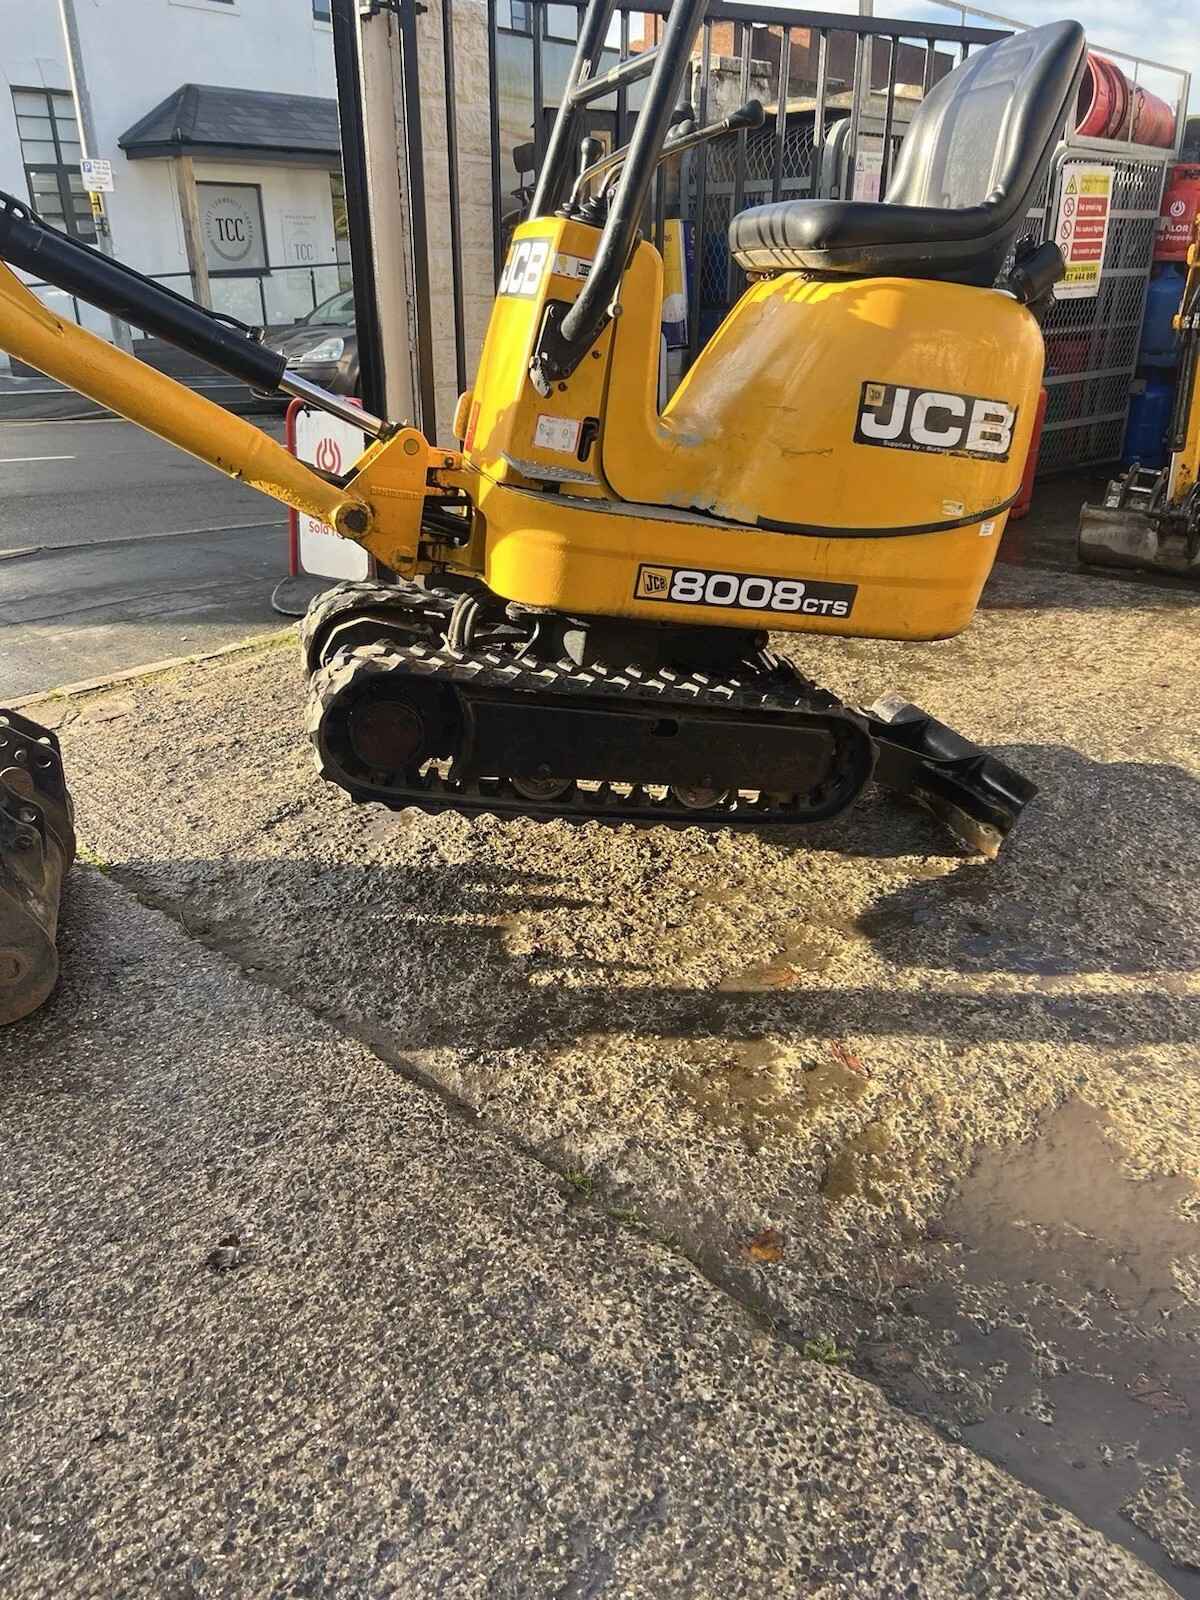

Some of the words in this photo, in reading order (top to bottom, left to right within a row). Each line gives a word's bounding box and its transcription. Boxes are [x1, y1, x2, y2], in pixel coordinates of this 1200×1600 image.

[215, 217, 245, 242] TCC
[293, 243, 314, 261] TCC
[500, 241, 549, 295] JCB
[860, 388, 1015, 454] JCB
[645, 574, 667, 592] JCB
